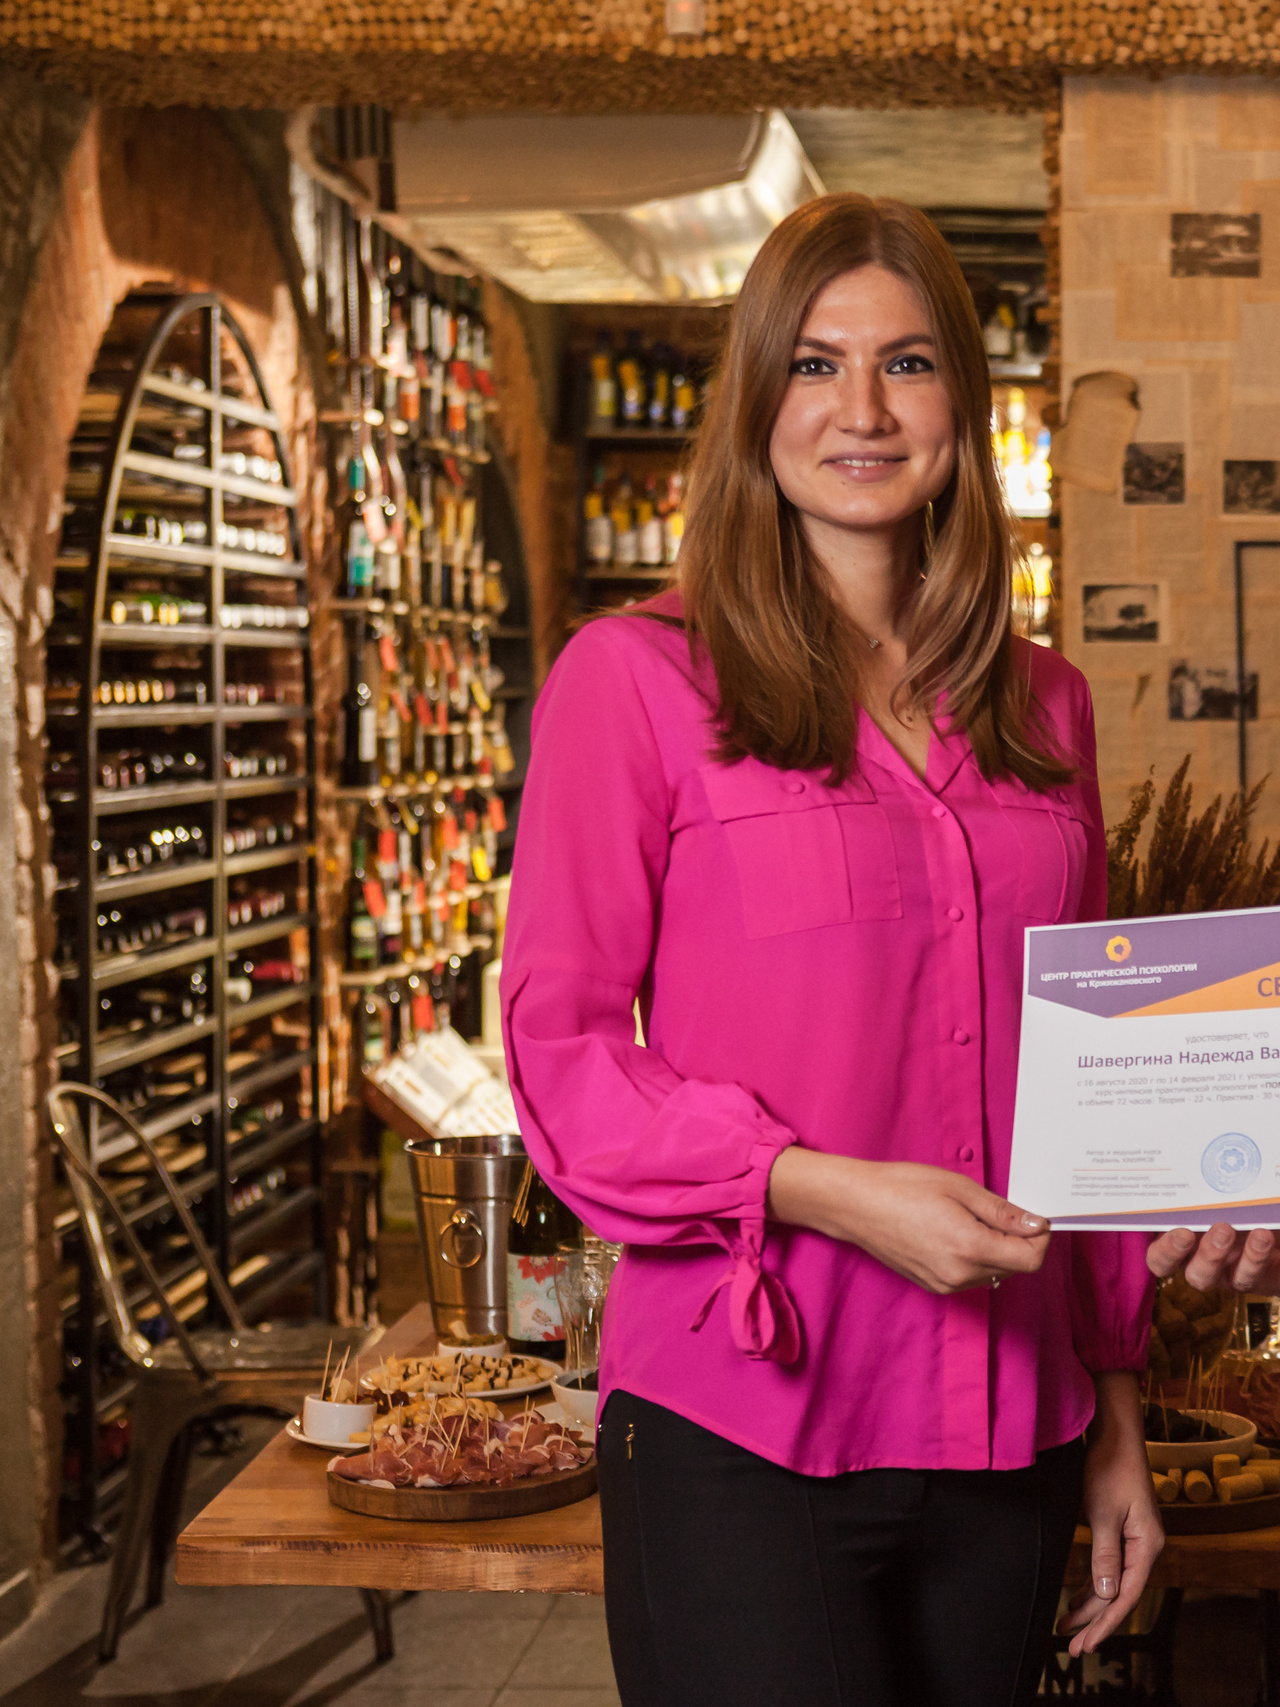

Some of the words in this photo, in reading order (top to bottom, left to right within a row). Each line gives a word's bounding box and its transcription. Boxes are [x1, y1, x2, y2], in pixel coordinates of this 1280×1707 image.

[1040, 971, 1069, 982] ЦЕНТР
[1070, 966, 1138, 980] ПРАКТИЧЕСКОЙ
[1139, 963, 1198, 975] ПСИХОЛОГИИ
[1089, 976, 1162, 989] Кржижановского
[1185, 1032, 1250, 1044] удостоверяет,
[1253, 1031, 1270, 1040] что
[1077, 1053, 1173, 1069] Шавергина
[1179, 1049, 1254, 1064] Надежда
[1095, 1079, 1126, 1088] августа
[1128, 1077, 1148, 1085] 2020
[1180, 1074, 1215, 1084] февраля
[1217, 1073, 1236, 1081] 2021
